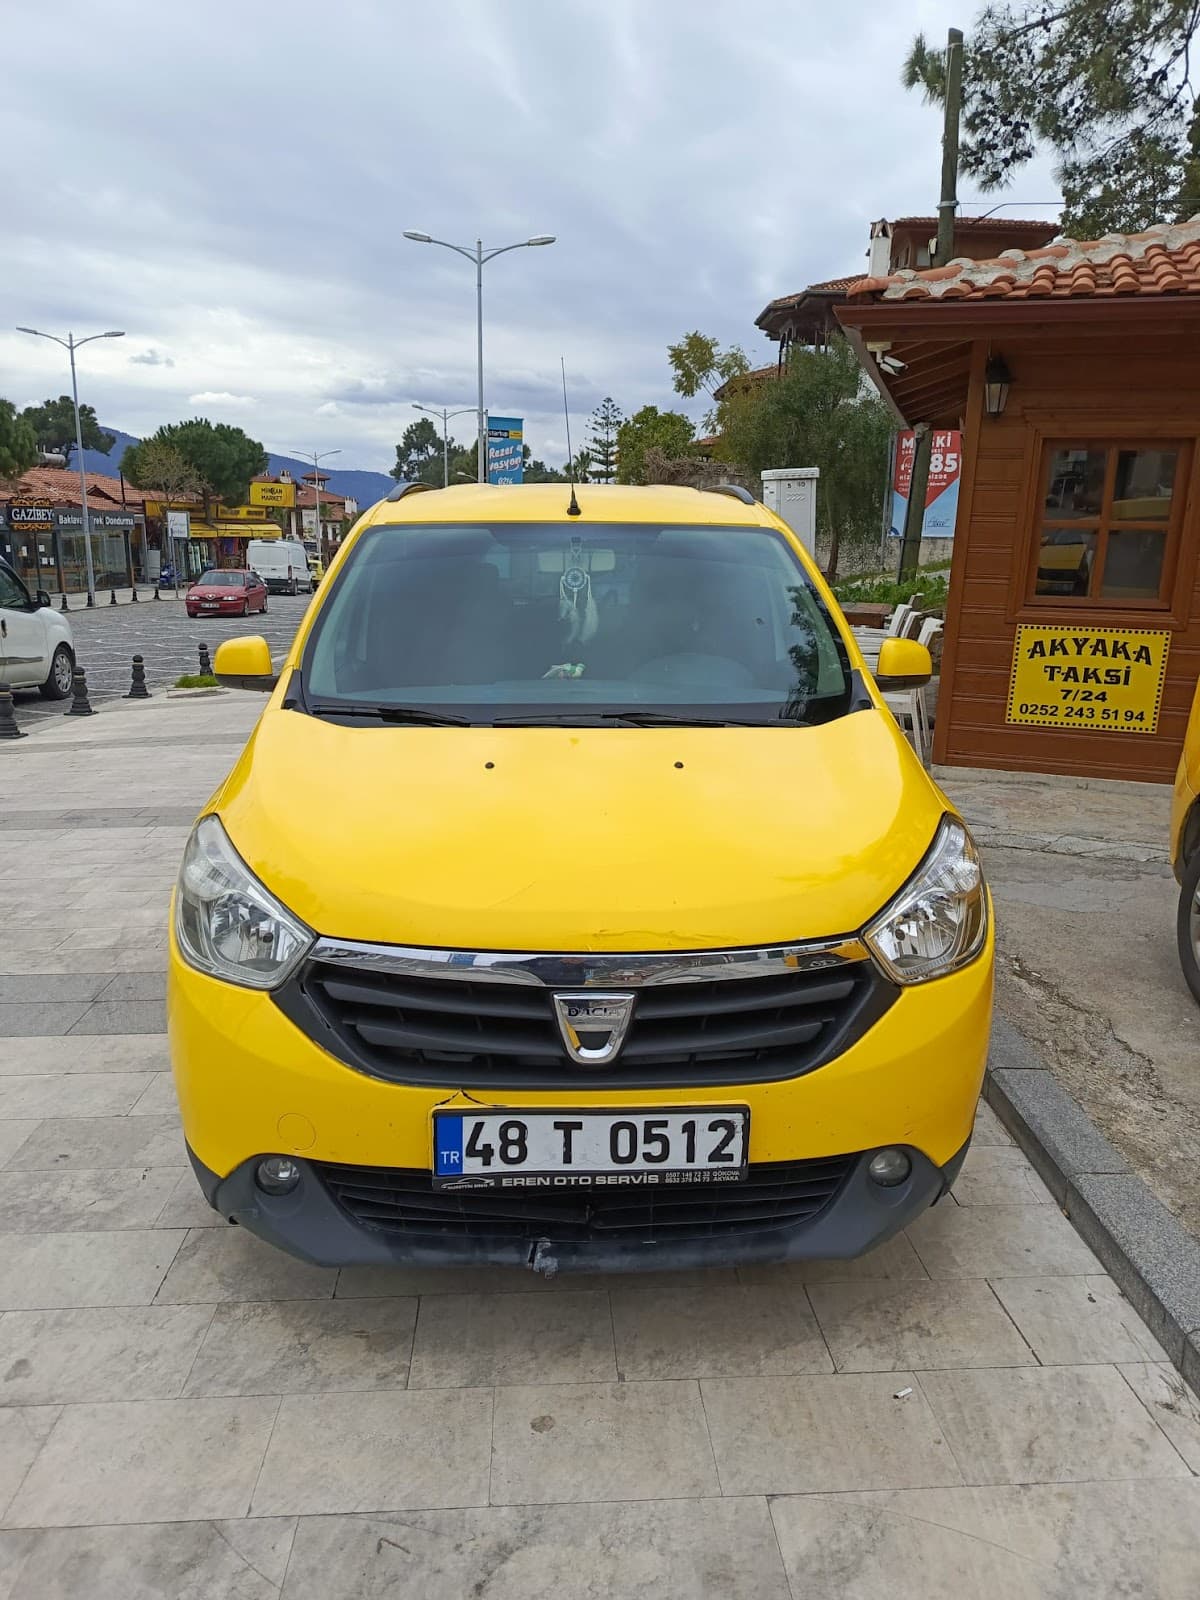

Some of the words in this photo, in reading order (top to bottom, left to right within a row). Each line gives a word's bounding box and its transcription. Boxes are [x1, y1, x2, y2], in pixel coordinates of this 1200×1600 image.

[902, 432, 952, 449] MKİ
[11, 507, 53, 521] GAZİBEY
[105, 516, 134, 526] Dondurma
[1027, 637, 1152, 666] AKYAKA
[1044, 665, 1132, 686] TAKSİ
[1060, 689, 1108, 702] 7/24
[1019, 703, 1059, 717] 0252
[1064, 706, 1095, 719] 243
[1101, 708, 1119, 721] 51
[1124, 710, 1145, 722] 94
[441, 1151, 460, 1165] TR
[465, 1120, 528, 1166] 48
[553, 1121, 583, 1164] T
[610, 1119, 735, 1164] 0512
[502, 1176, 550, 1187] EREN
[554, 1176, 592, 1186] OTO
[595, 1172, 659, 1185] SERVİS
